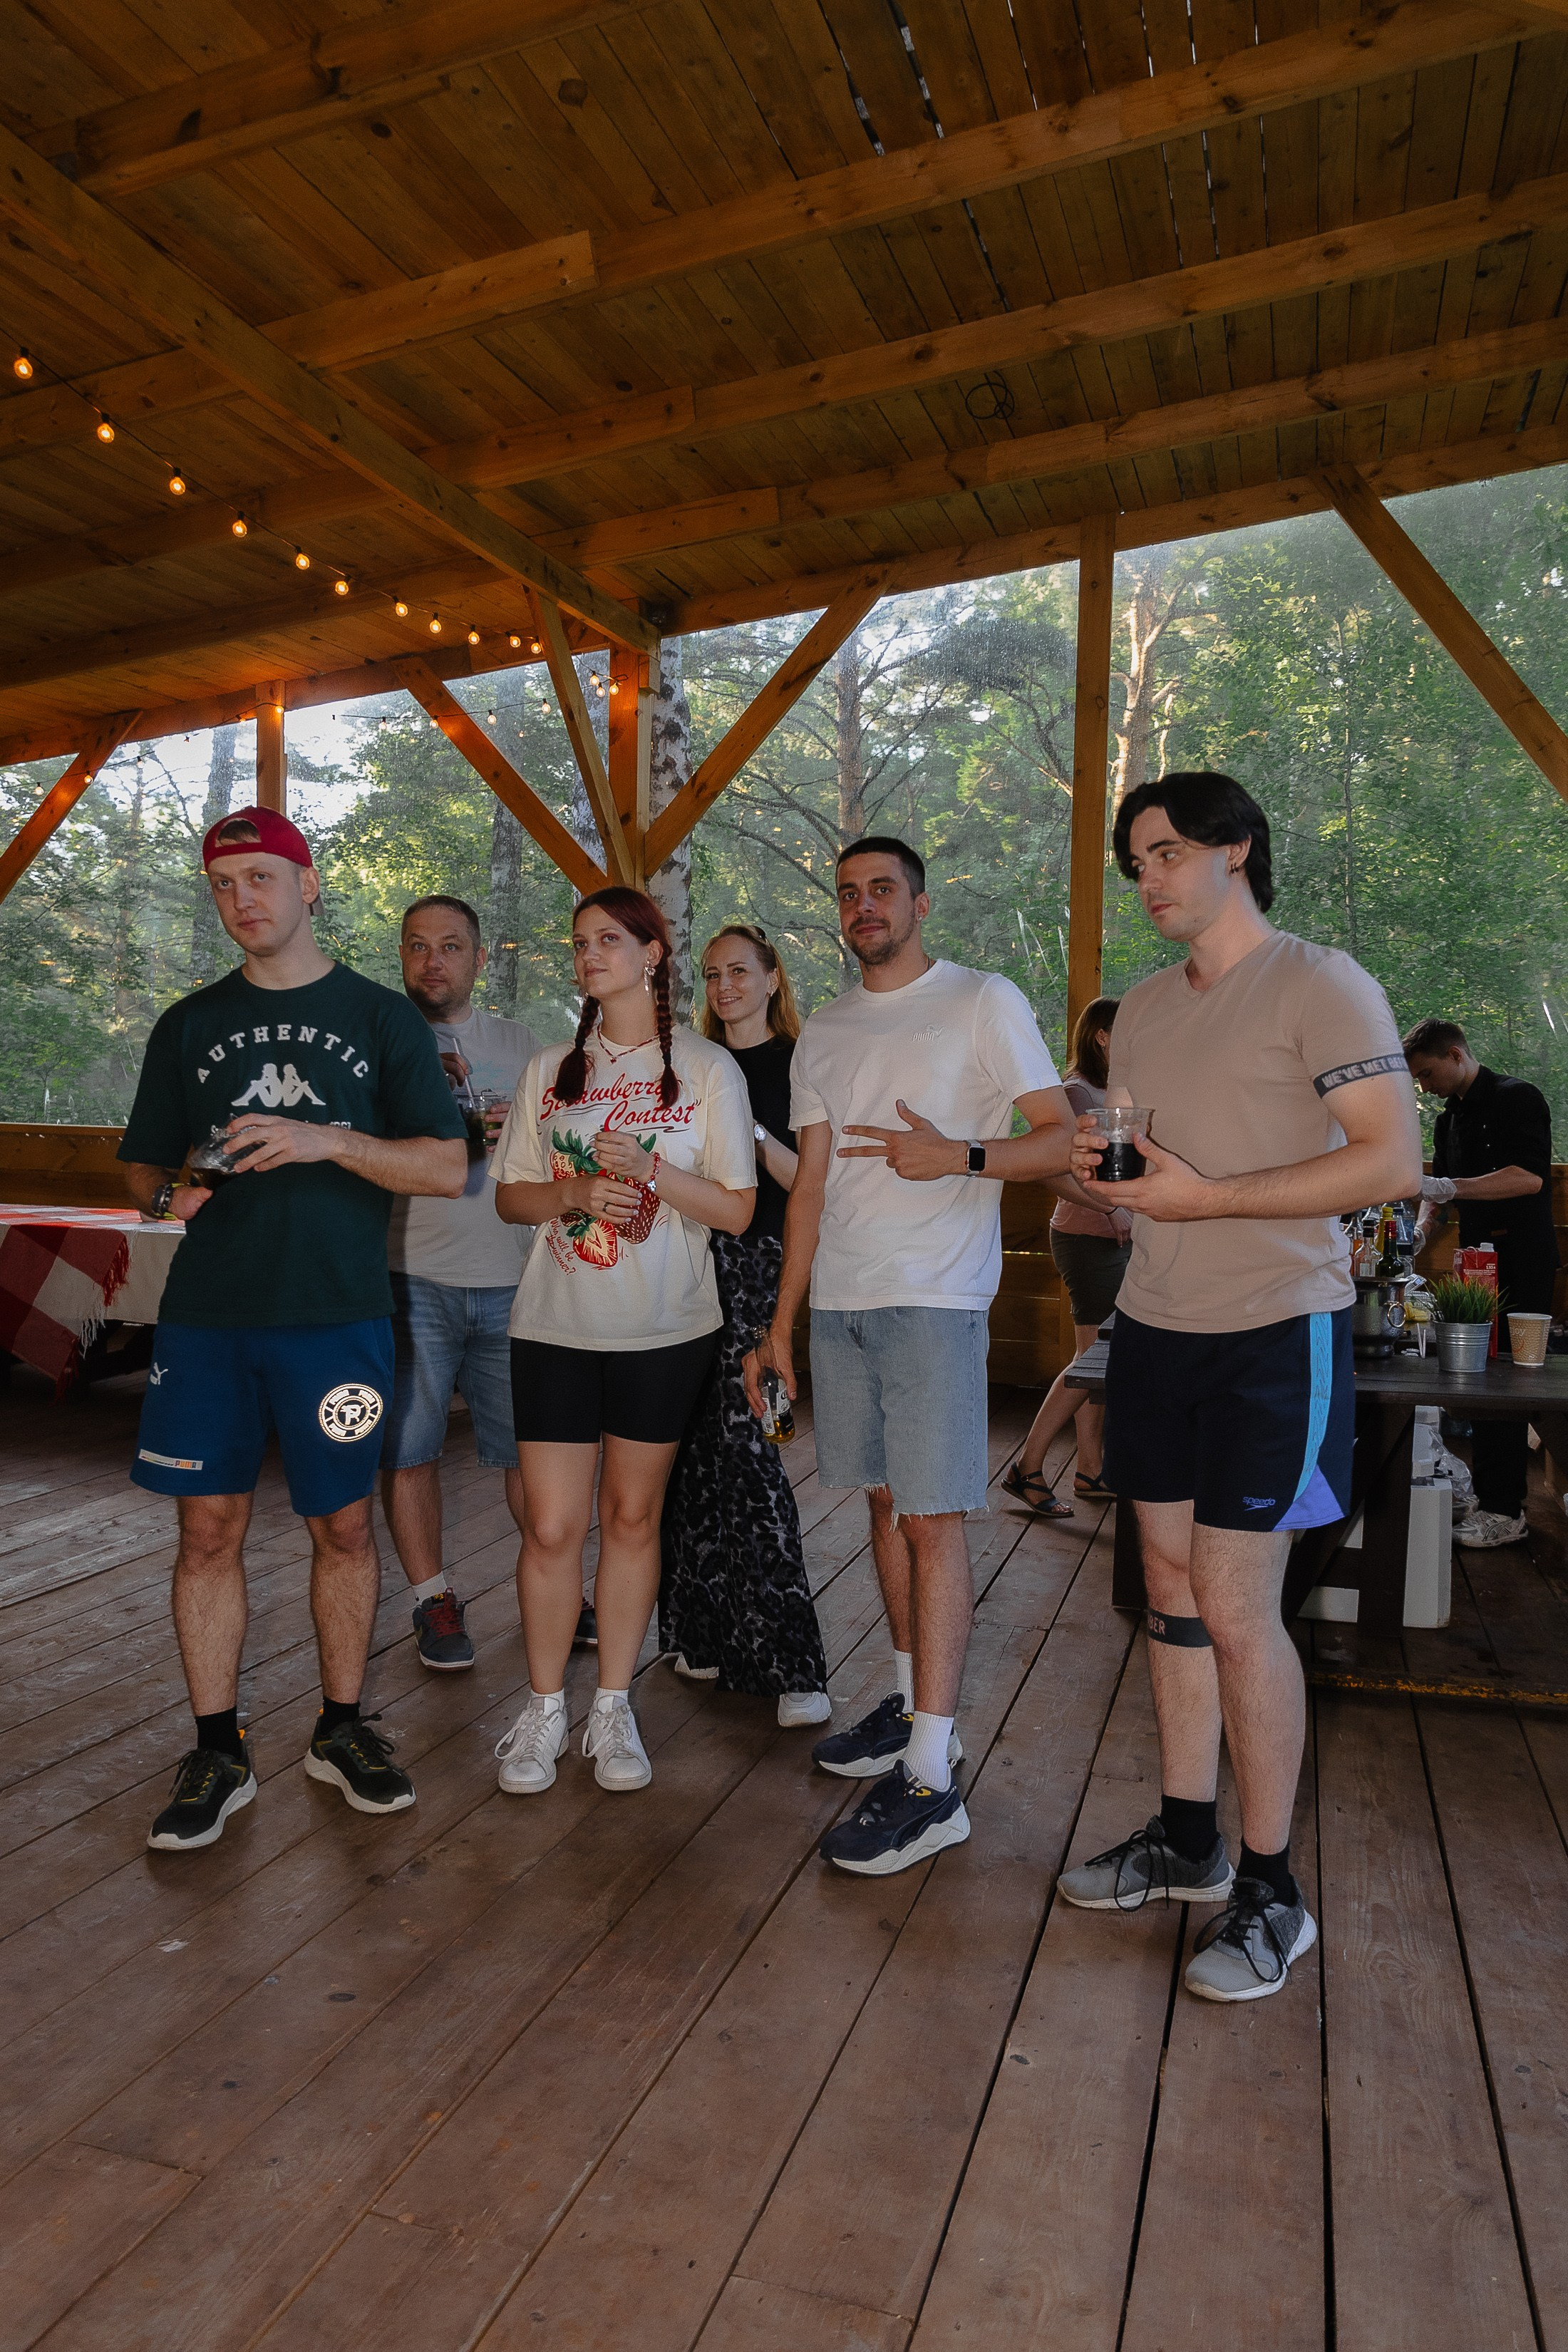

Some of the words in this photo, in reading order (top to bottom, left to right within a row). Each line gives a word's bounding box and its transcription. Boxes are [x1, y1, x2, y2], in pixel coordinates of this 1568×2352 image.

[197, 1024, 368, 1083] AUTHENTIC
[552, 1247, 576, 1275] winner?
[557, 1236, 569, 1252] will
[565, 1251, 575, 1262] be
[175, 1460, 197, 1468] PUMA
[1242, 1497, 1276, 1505] speedo
[1147, 1614, 1166, 1636] BER
